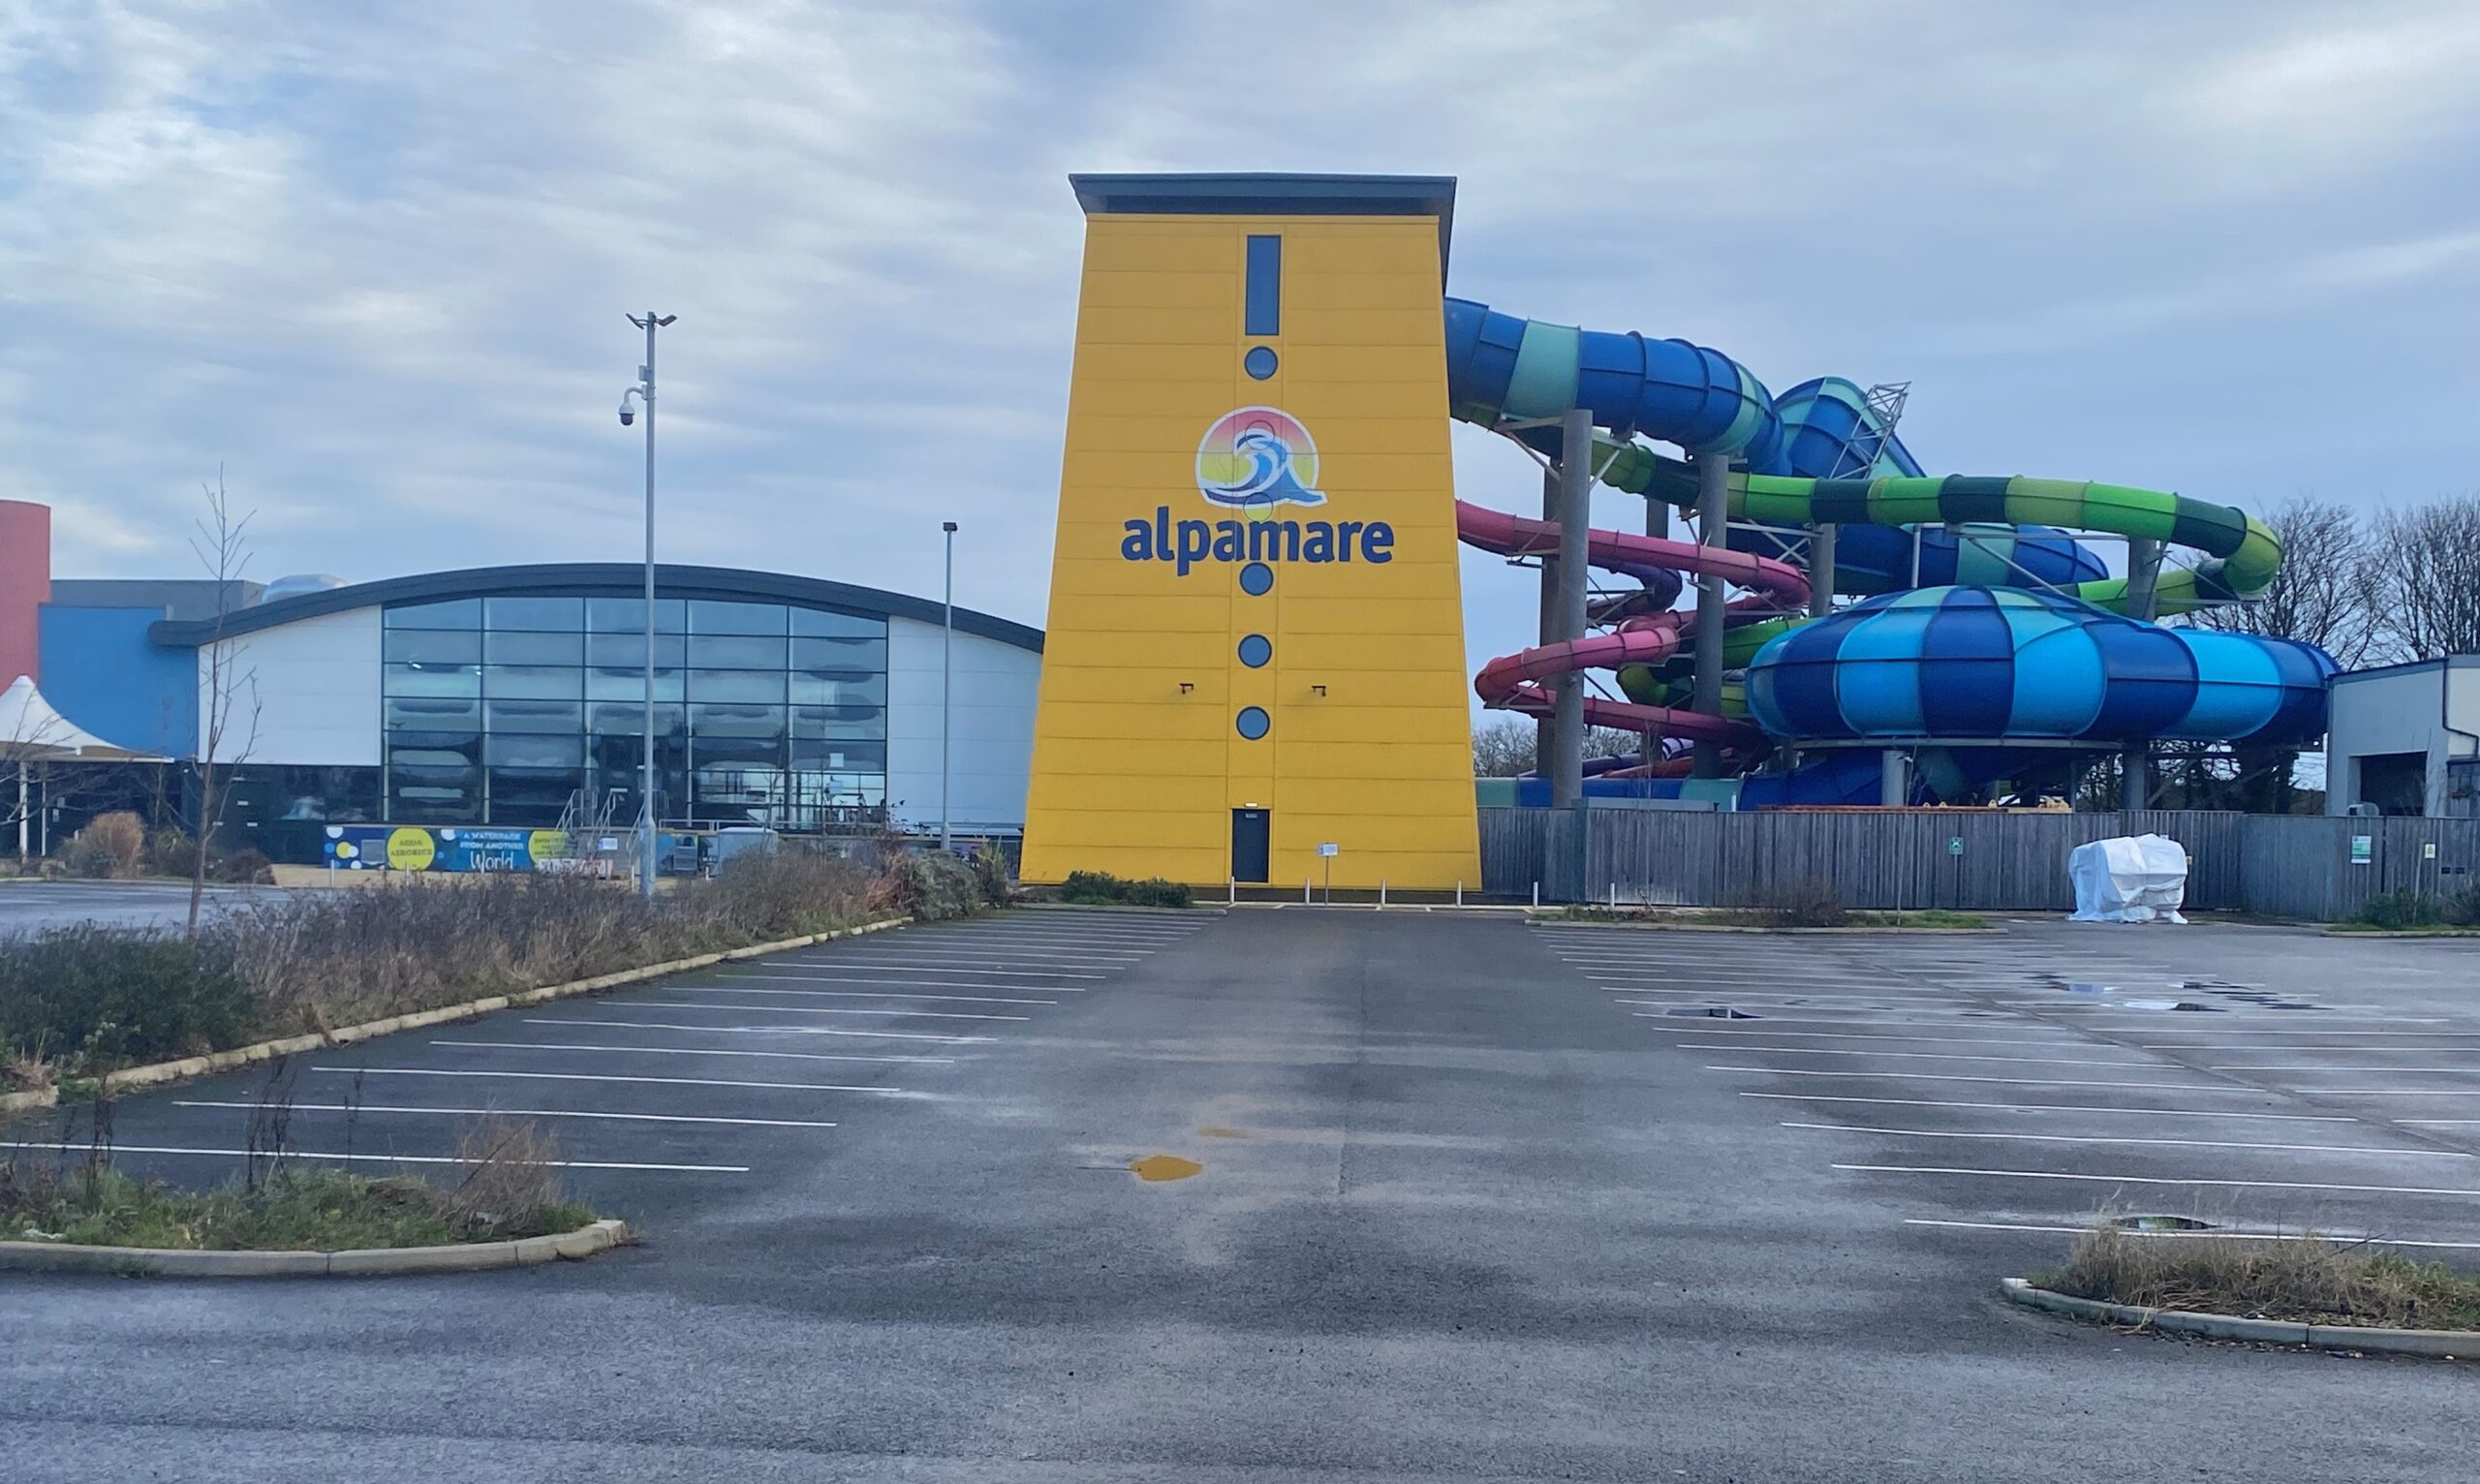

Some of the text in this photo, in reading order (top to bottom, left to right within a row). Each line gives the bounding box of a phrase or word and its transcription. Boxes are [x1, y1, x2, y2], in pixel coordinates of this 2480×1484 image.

[1121, 506, 1395, 576] alpamare
[471, 832, 521, 841] WATERPARK
[485, 842, 524, 850] ANOTHER
[470, 850, 514, 870] World
